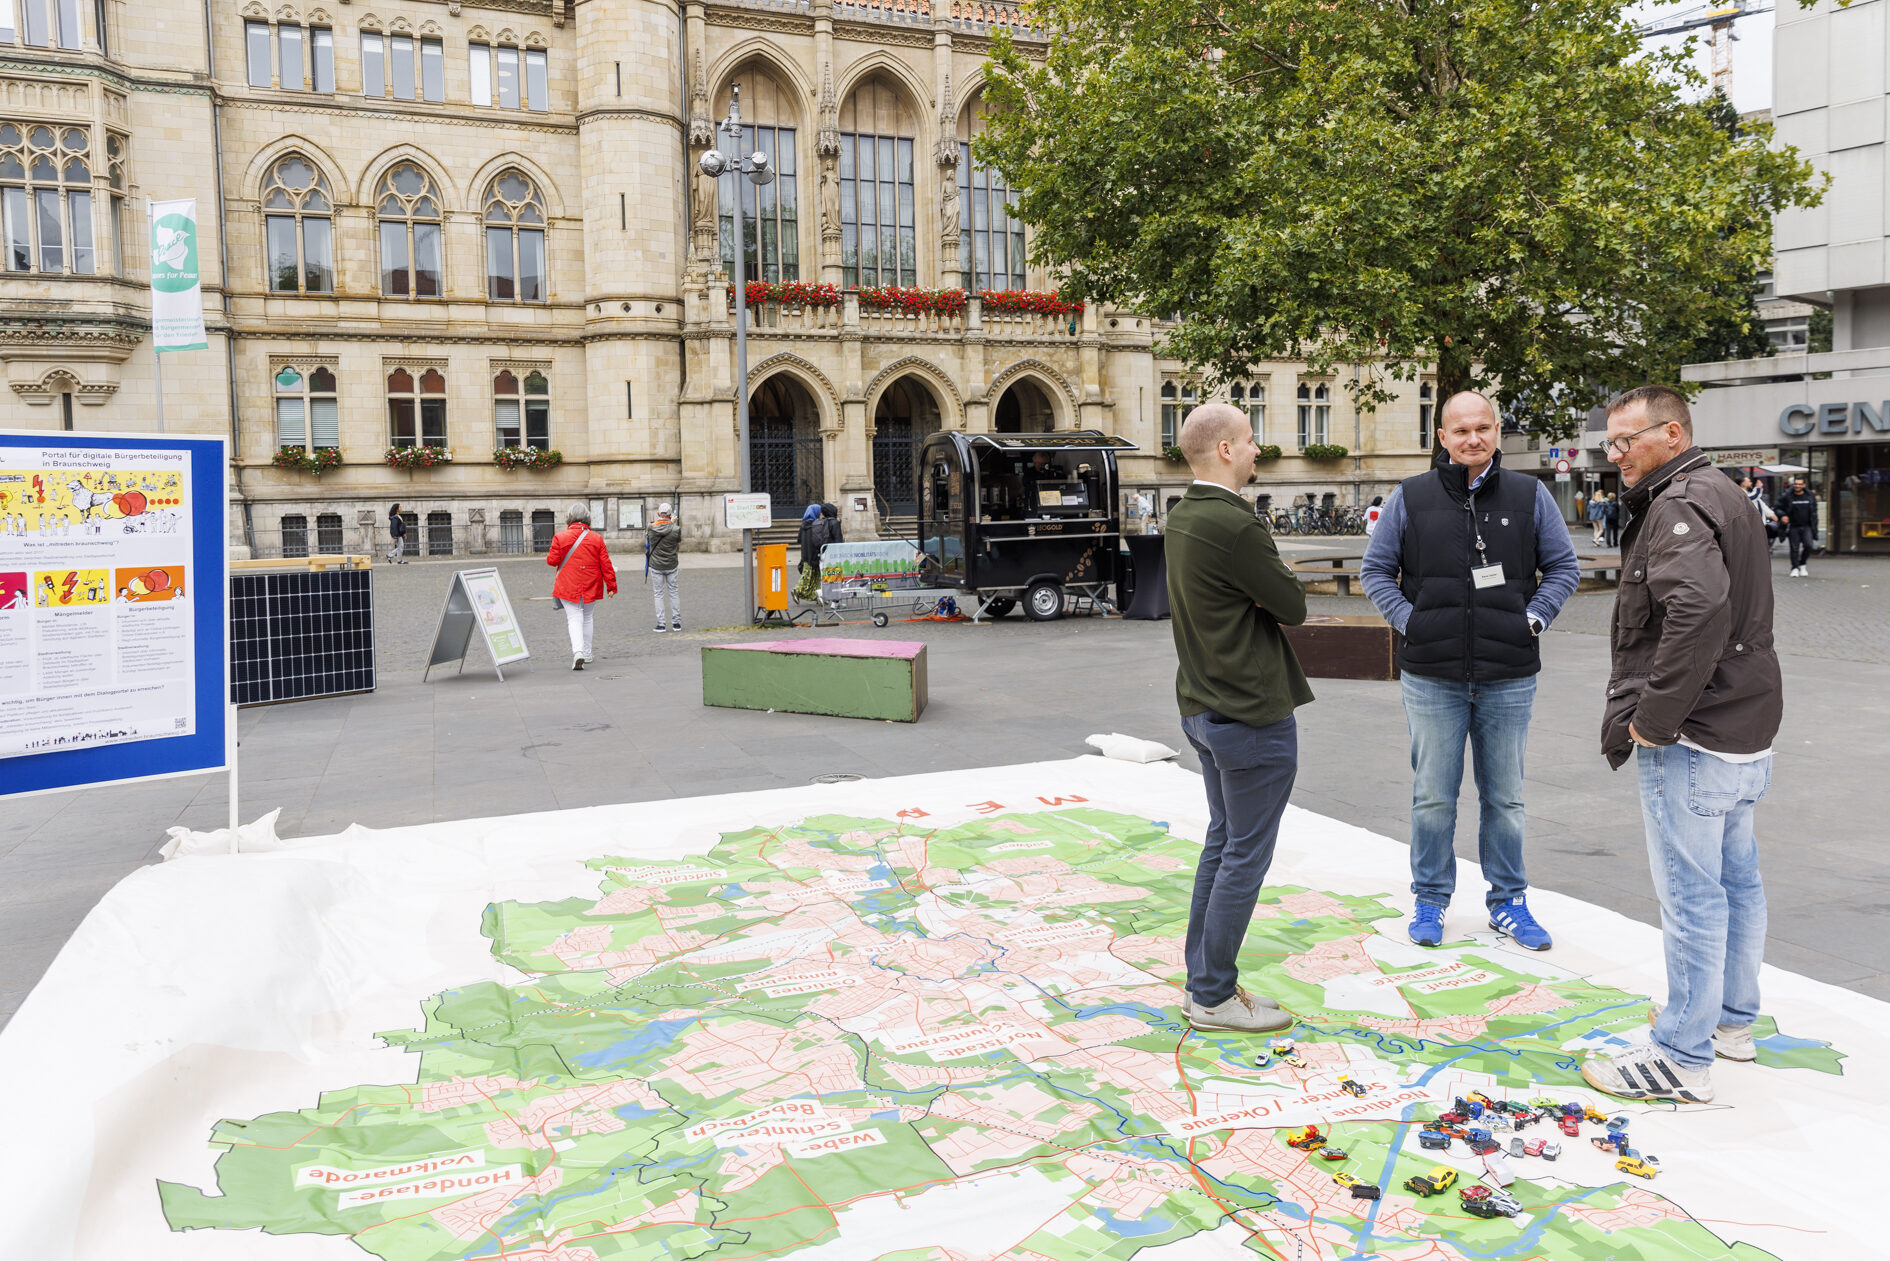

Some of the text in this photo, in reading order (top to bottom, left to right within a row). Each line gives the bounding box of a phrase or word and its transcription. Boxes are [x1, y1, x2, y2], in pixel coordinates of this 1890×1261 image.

[115, 453, 183, 461] Bürgerbeteiligung
[1181, 1082, 1387, 1133] Scunter- / Okeraue
[1332, 1089, 1430, 1119] Nördliche
[692, 1104, 815, 1137] Beberbach
[727, 1121, 841, 1140] Schunter-
[799, 1133, 875, 1152] Wabe-
[308, 1155, 475, 1184] Volkmarode
[348, 1170, 510, 1201] Hondelage-
